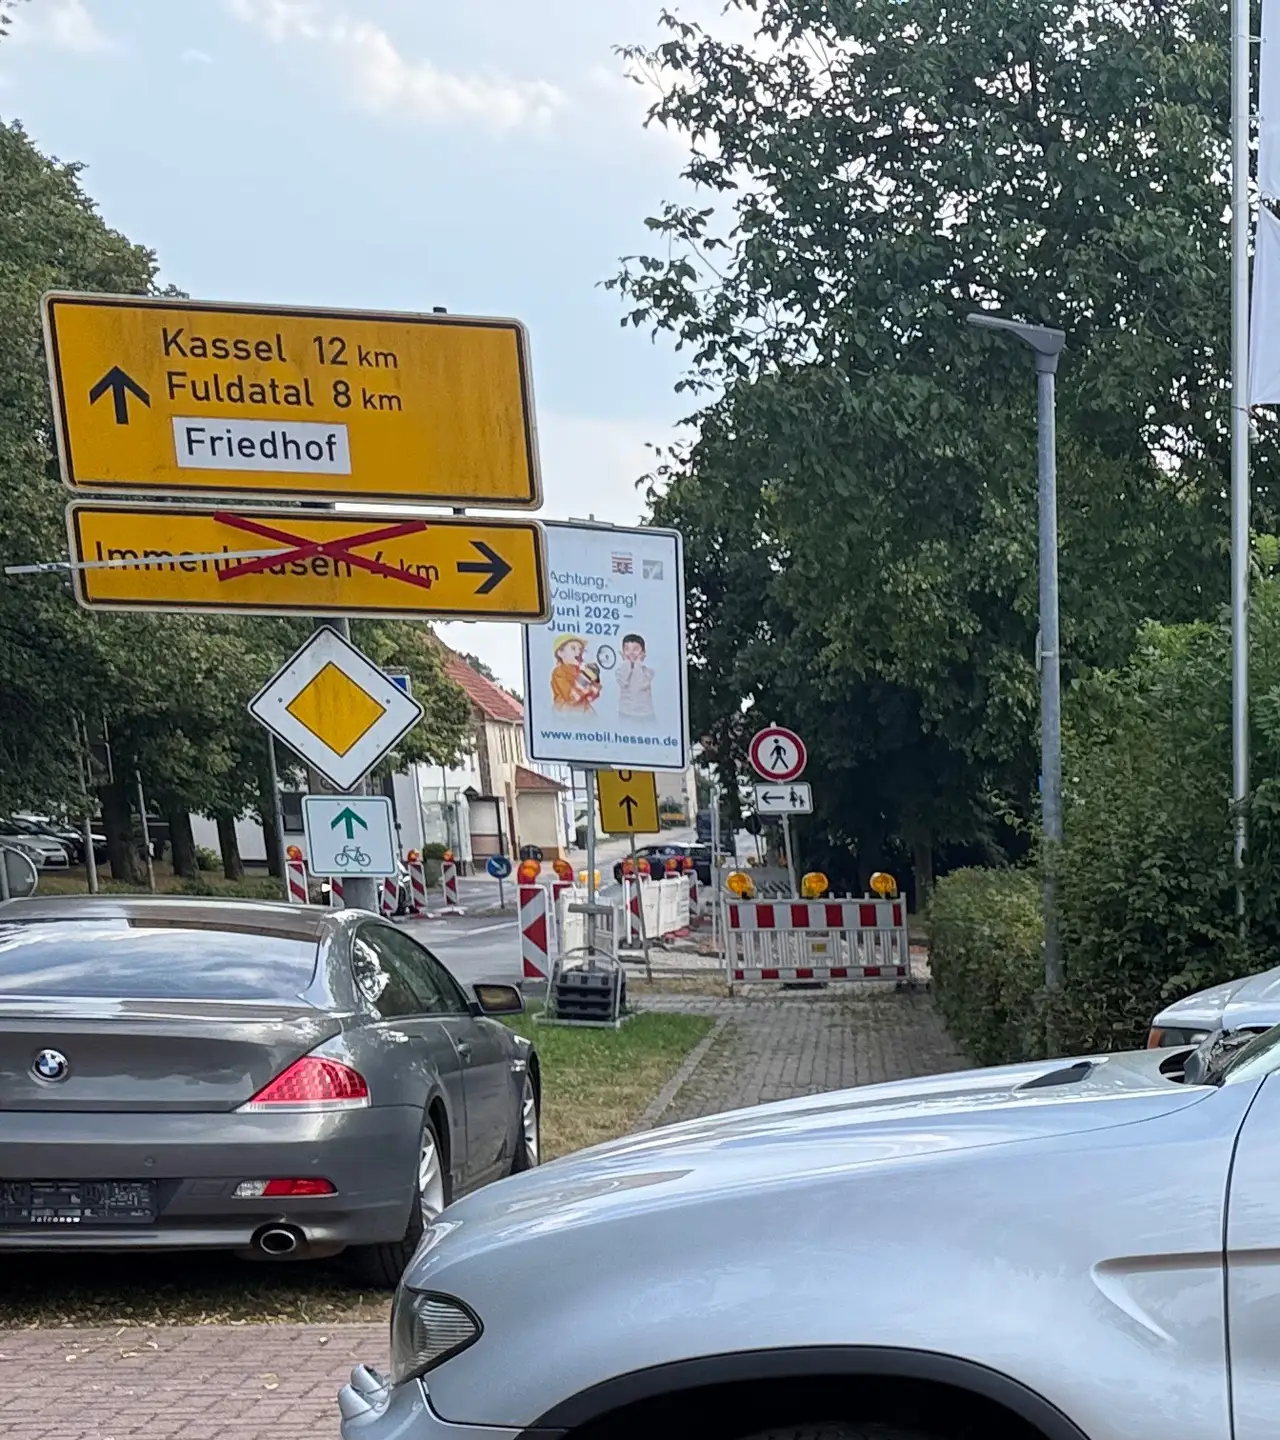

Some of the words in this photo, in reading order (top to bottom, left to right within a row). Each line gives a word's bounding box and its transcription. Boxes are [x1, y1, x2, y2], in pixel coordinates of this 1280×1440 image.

[161, 327, 288, 363] Kassel
[313, 335, 348, 366] 12
[357, 344, 398, 369] km
[166, 370, 315, 408] Fuldatal
[332, 379, 352, 409] 8
[361, 387, 403, 412] km
[185, 426, 337, 462] Friedhof
[550, 587, 637, 609] Vollsperrung!
[584, 605, 620, 621] 2026
[547, 619, 581, 634] Juni
[585, 622, 621, 636] 2027
[540, 729, 679, 747] www.mobil.hessen.de
